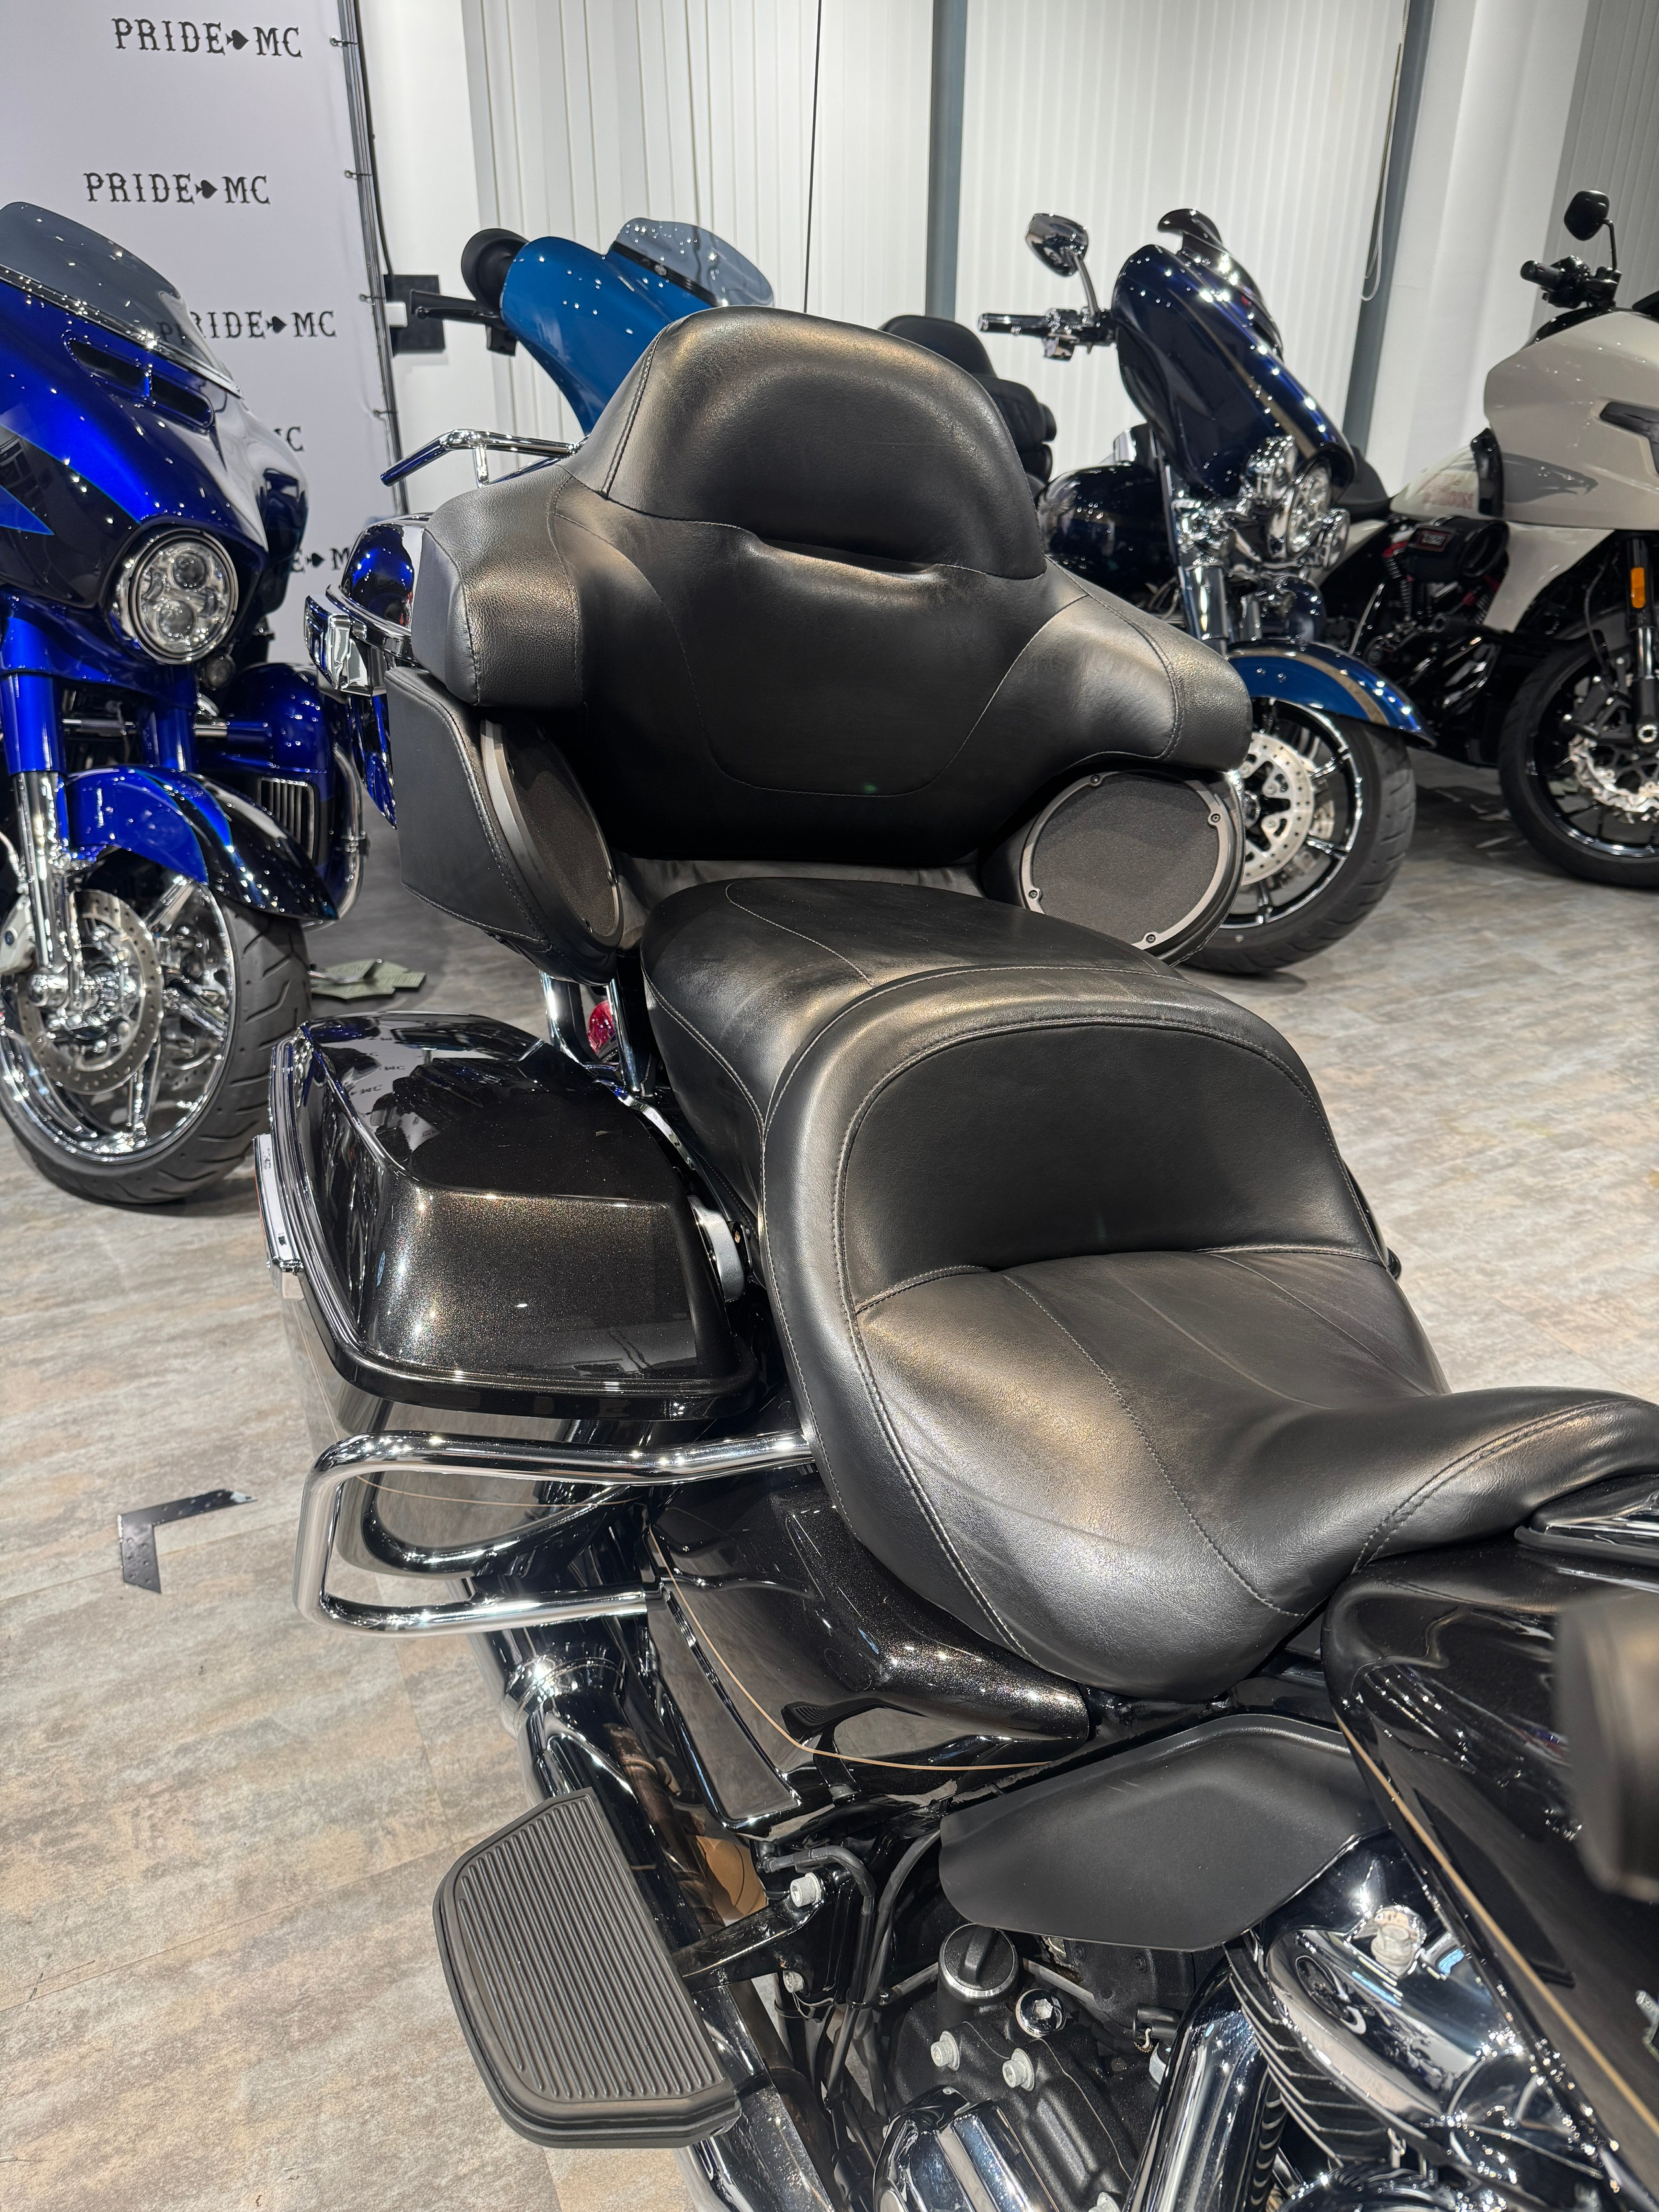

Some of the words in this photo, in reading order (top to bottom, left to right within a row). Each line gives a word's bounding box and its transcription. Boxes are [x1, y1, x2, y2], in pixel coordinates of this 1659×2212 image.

[111, 17, 226, 56] PRIDE
[253, 26, 303, 58] MC
[83, 172, 195, 205] PRIDE
[222, 175, 271, 205] MC
[291, 310, 337, 338] MC
